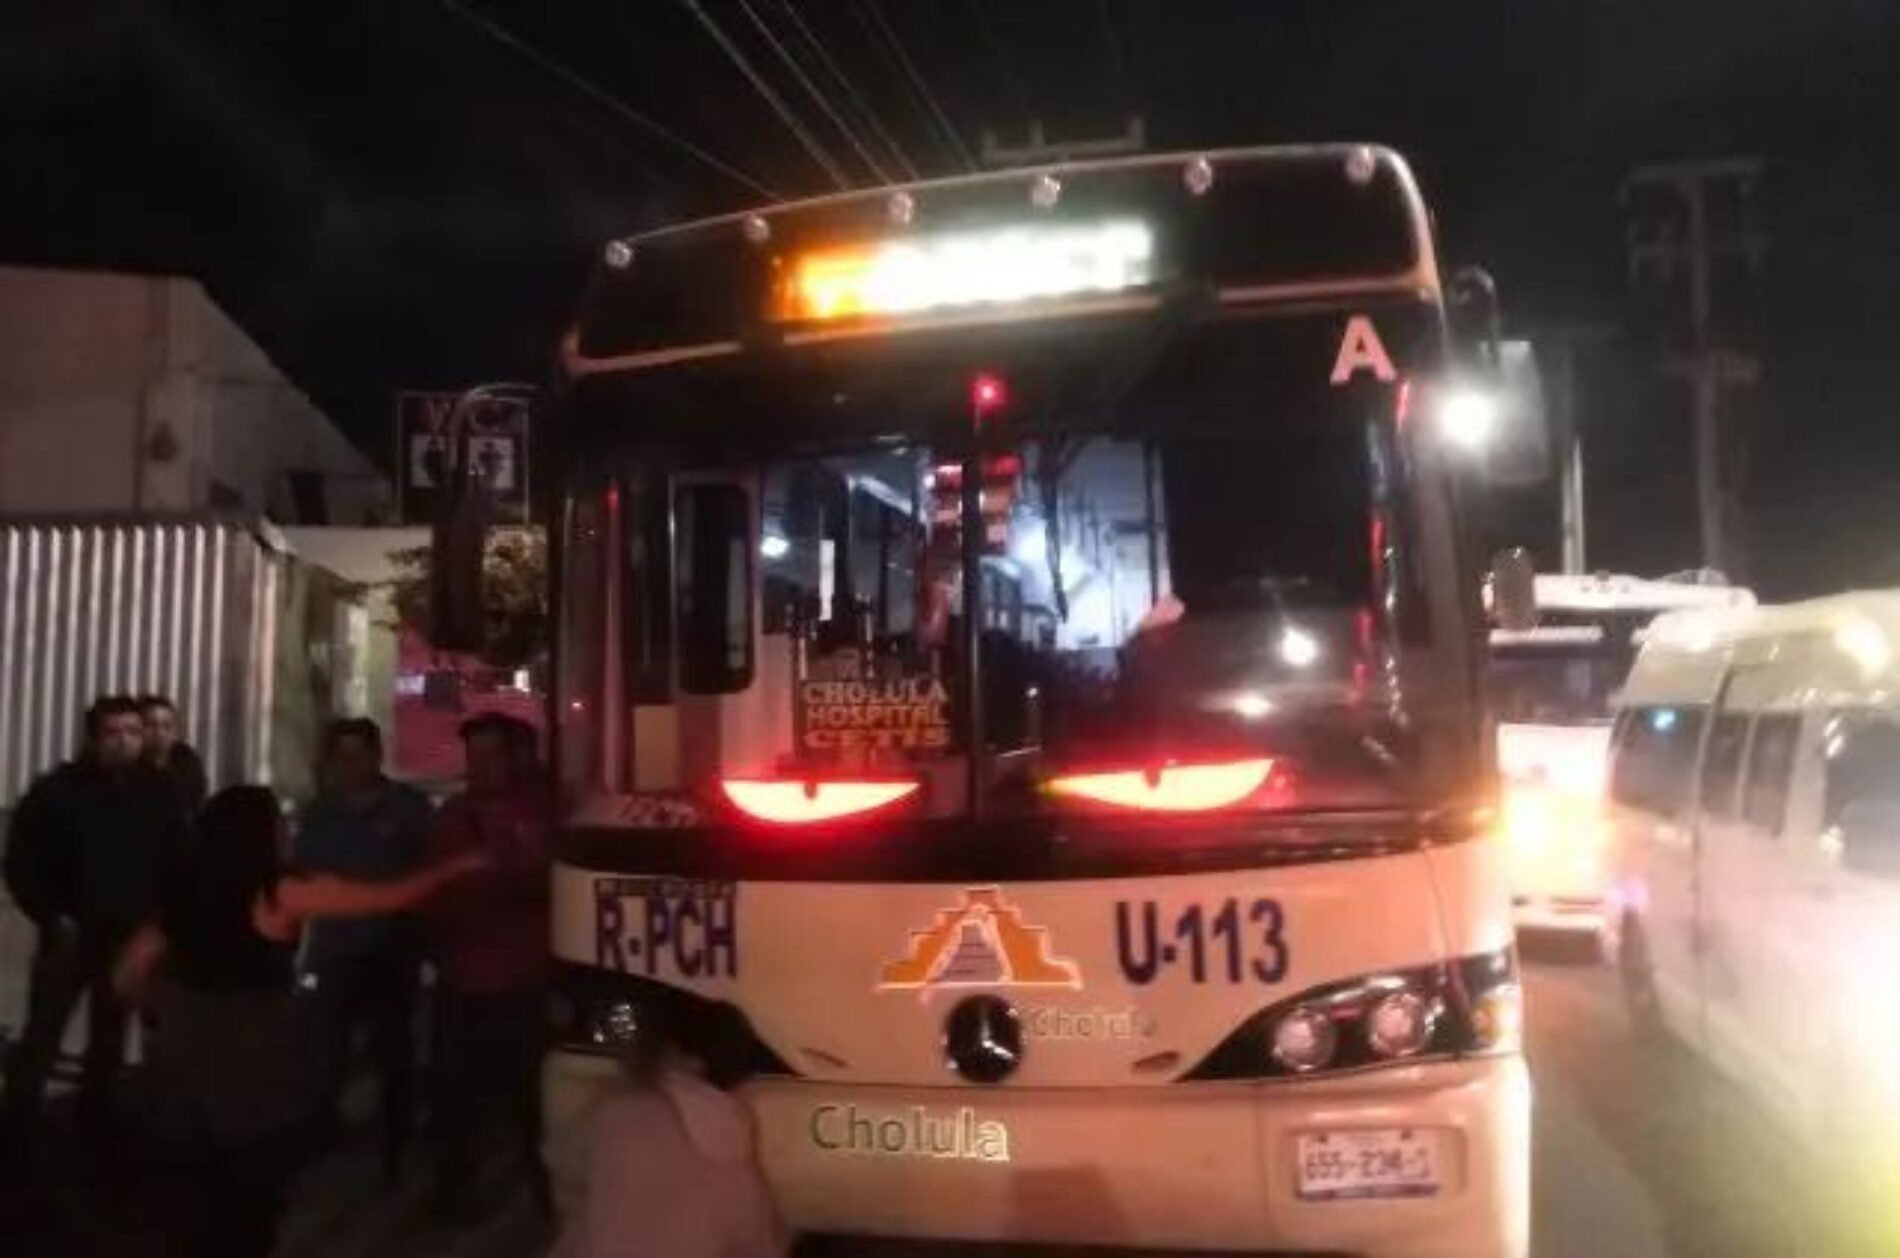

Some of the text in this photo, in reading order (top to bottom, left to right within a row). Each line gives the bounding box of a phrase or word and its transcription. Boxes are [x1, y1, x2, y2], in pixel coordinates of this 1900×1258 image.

[1330, 315, 1397, 383] A
[804, 677, 948, 706] CHOLULA
[806, 702, 948, 728] HOSPITAL
[594, 895, 736, 979] R-PCH
[1114, 897, 1290, 985] U-113
[809, 1103, 1010, 1162] Cholula
